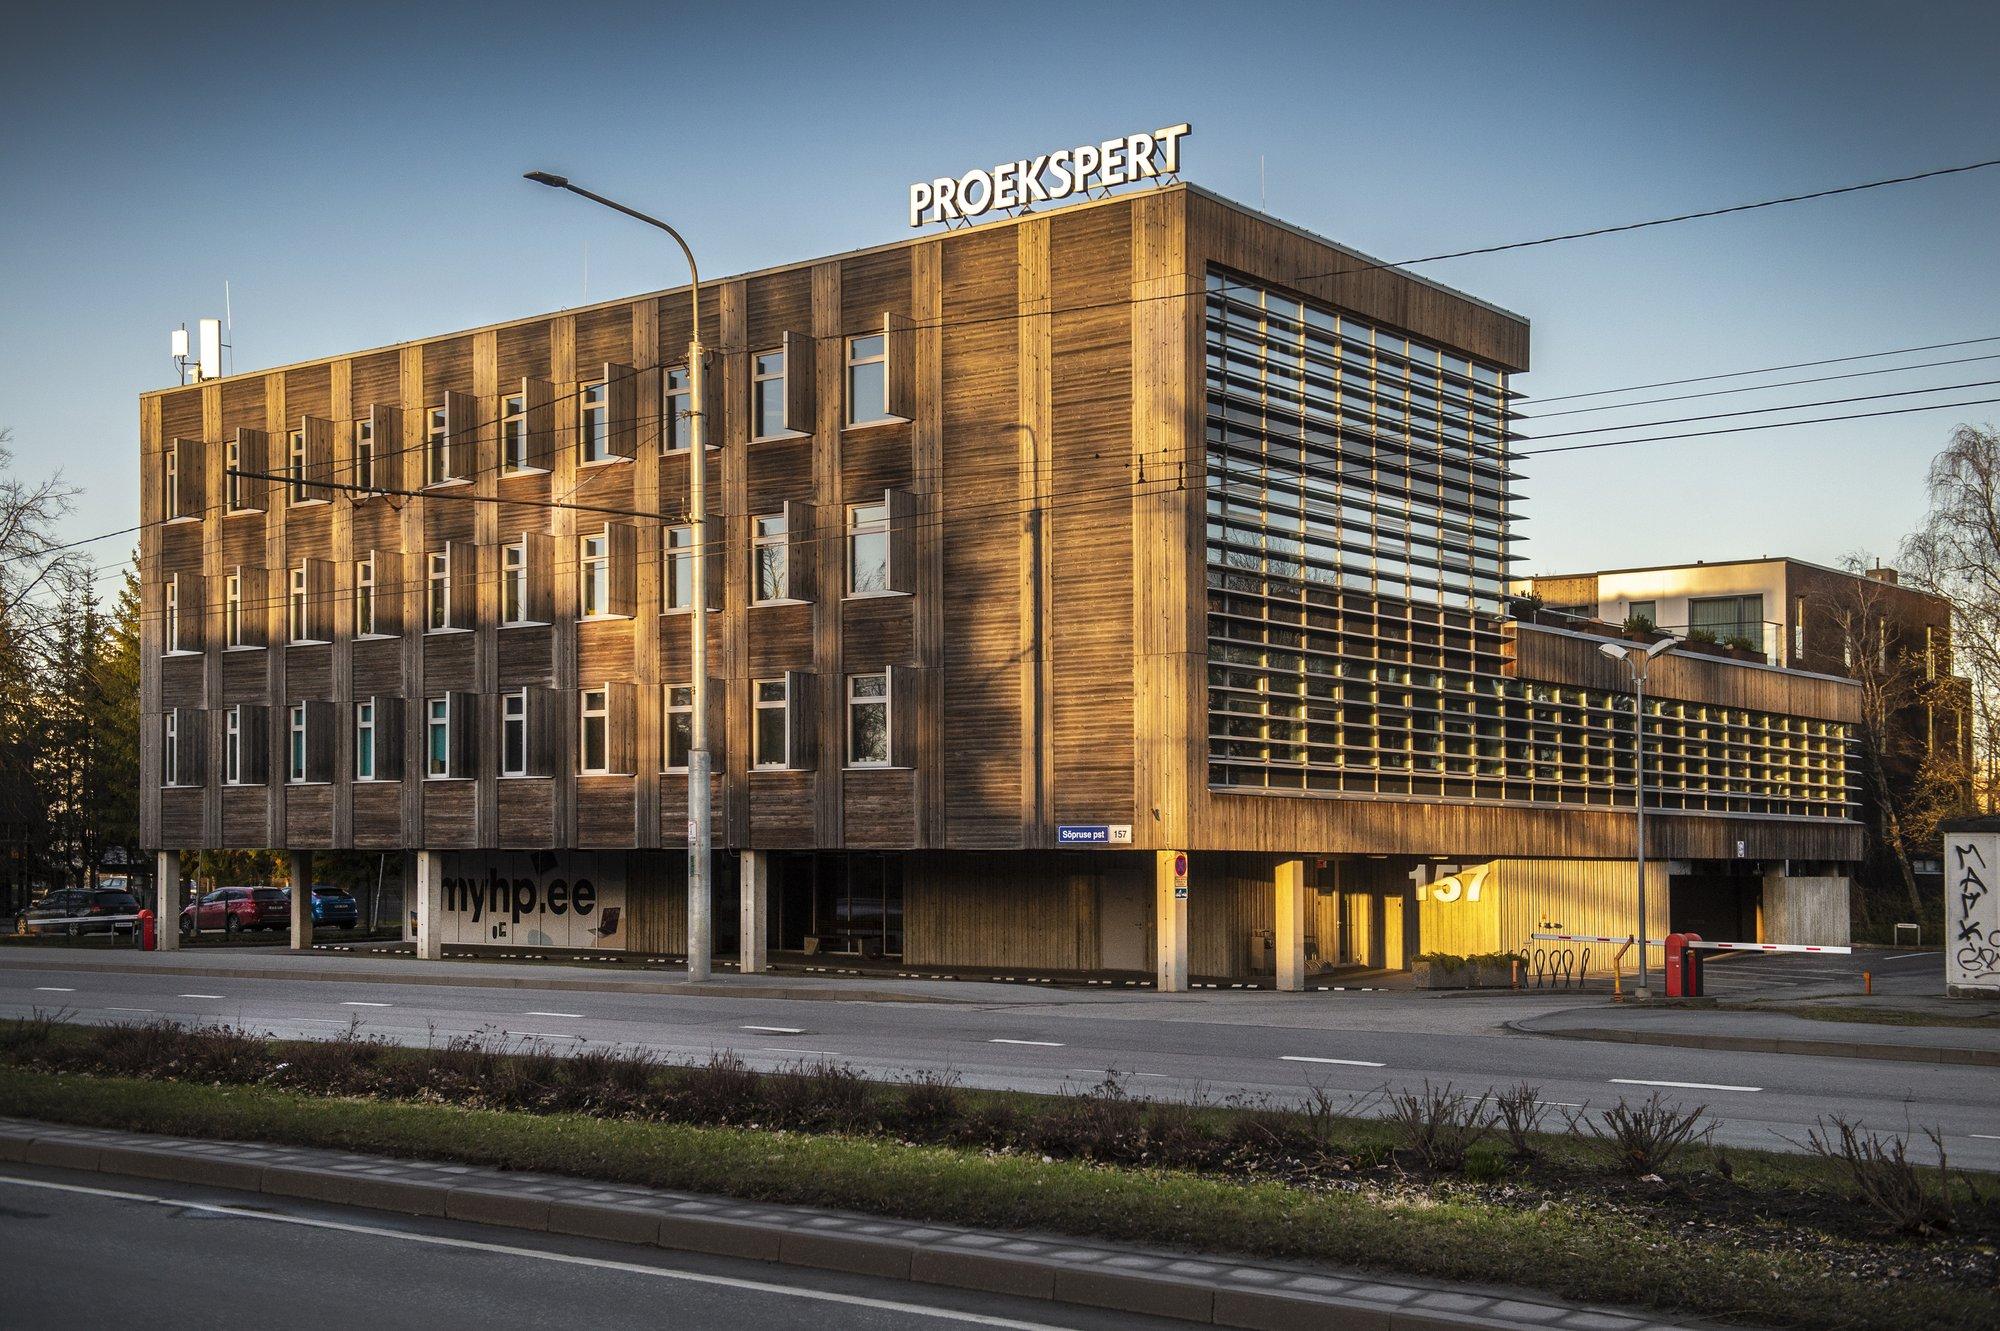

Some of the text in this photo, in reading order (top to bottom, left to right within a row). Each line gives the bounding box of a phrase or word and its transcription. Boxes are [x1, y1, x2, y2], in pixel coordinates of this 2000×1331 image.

[909, 122, 1192, 228] PROEKSPERT
[1062, 830, 1105, 841] Sõpruse pst
[1114, 830, 1127, 839] 157
[441, 867, 596, 924] myhp.ee
[1408, 864, 1490, 903] 157
